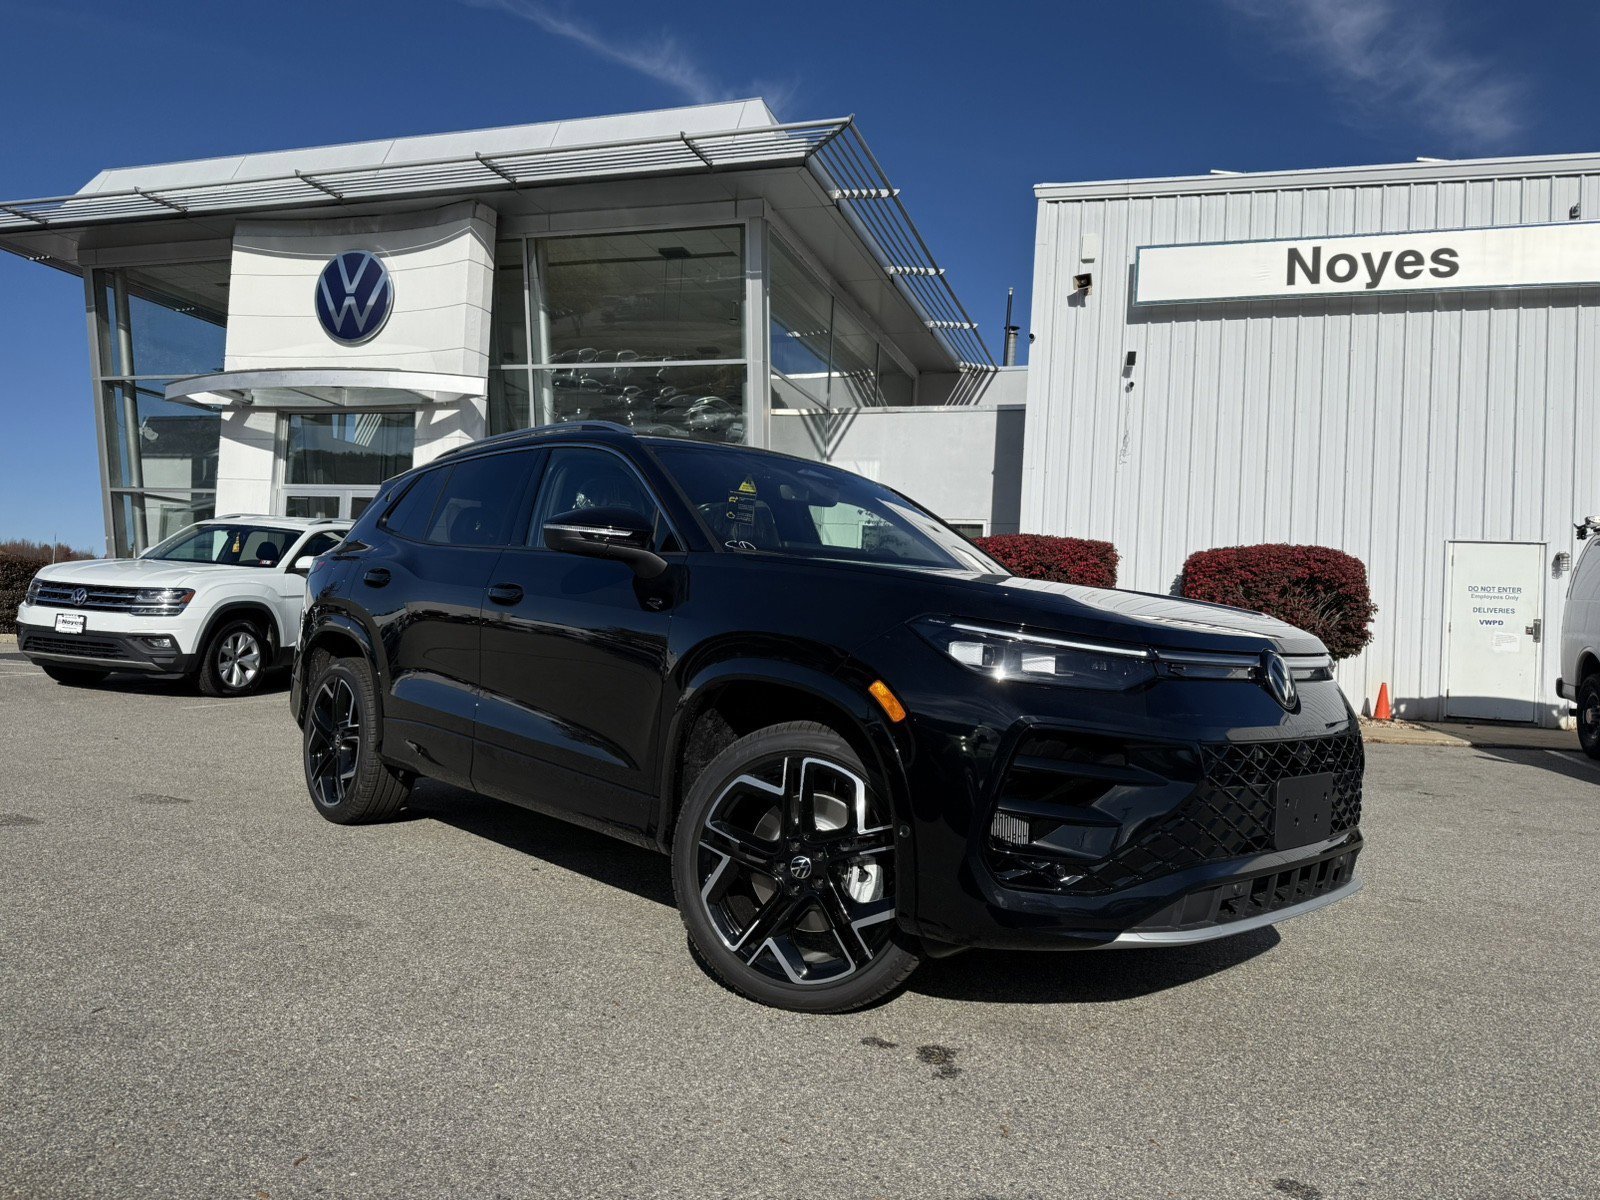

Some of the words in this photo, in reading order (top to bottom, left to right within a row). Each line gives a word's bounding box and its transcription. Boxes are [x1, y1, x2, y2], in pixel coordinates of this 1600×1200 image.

[1286, 245, 1460, 290] Noyes
[316, 250, 391, 341] VW
[1498, 586, 1522, 594] ENTER
[1471, 593, 1504, 601] Employees
[1472, 606, 1516, 614] DELIVERIES
